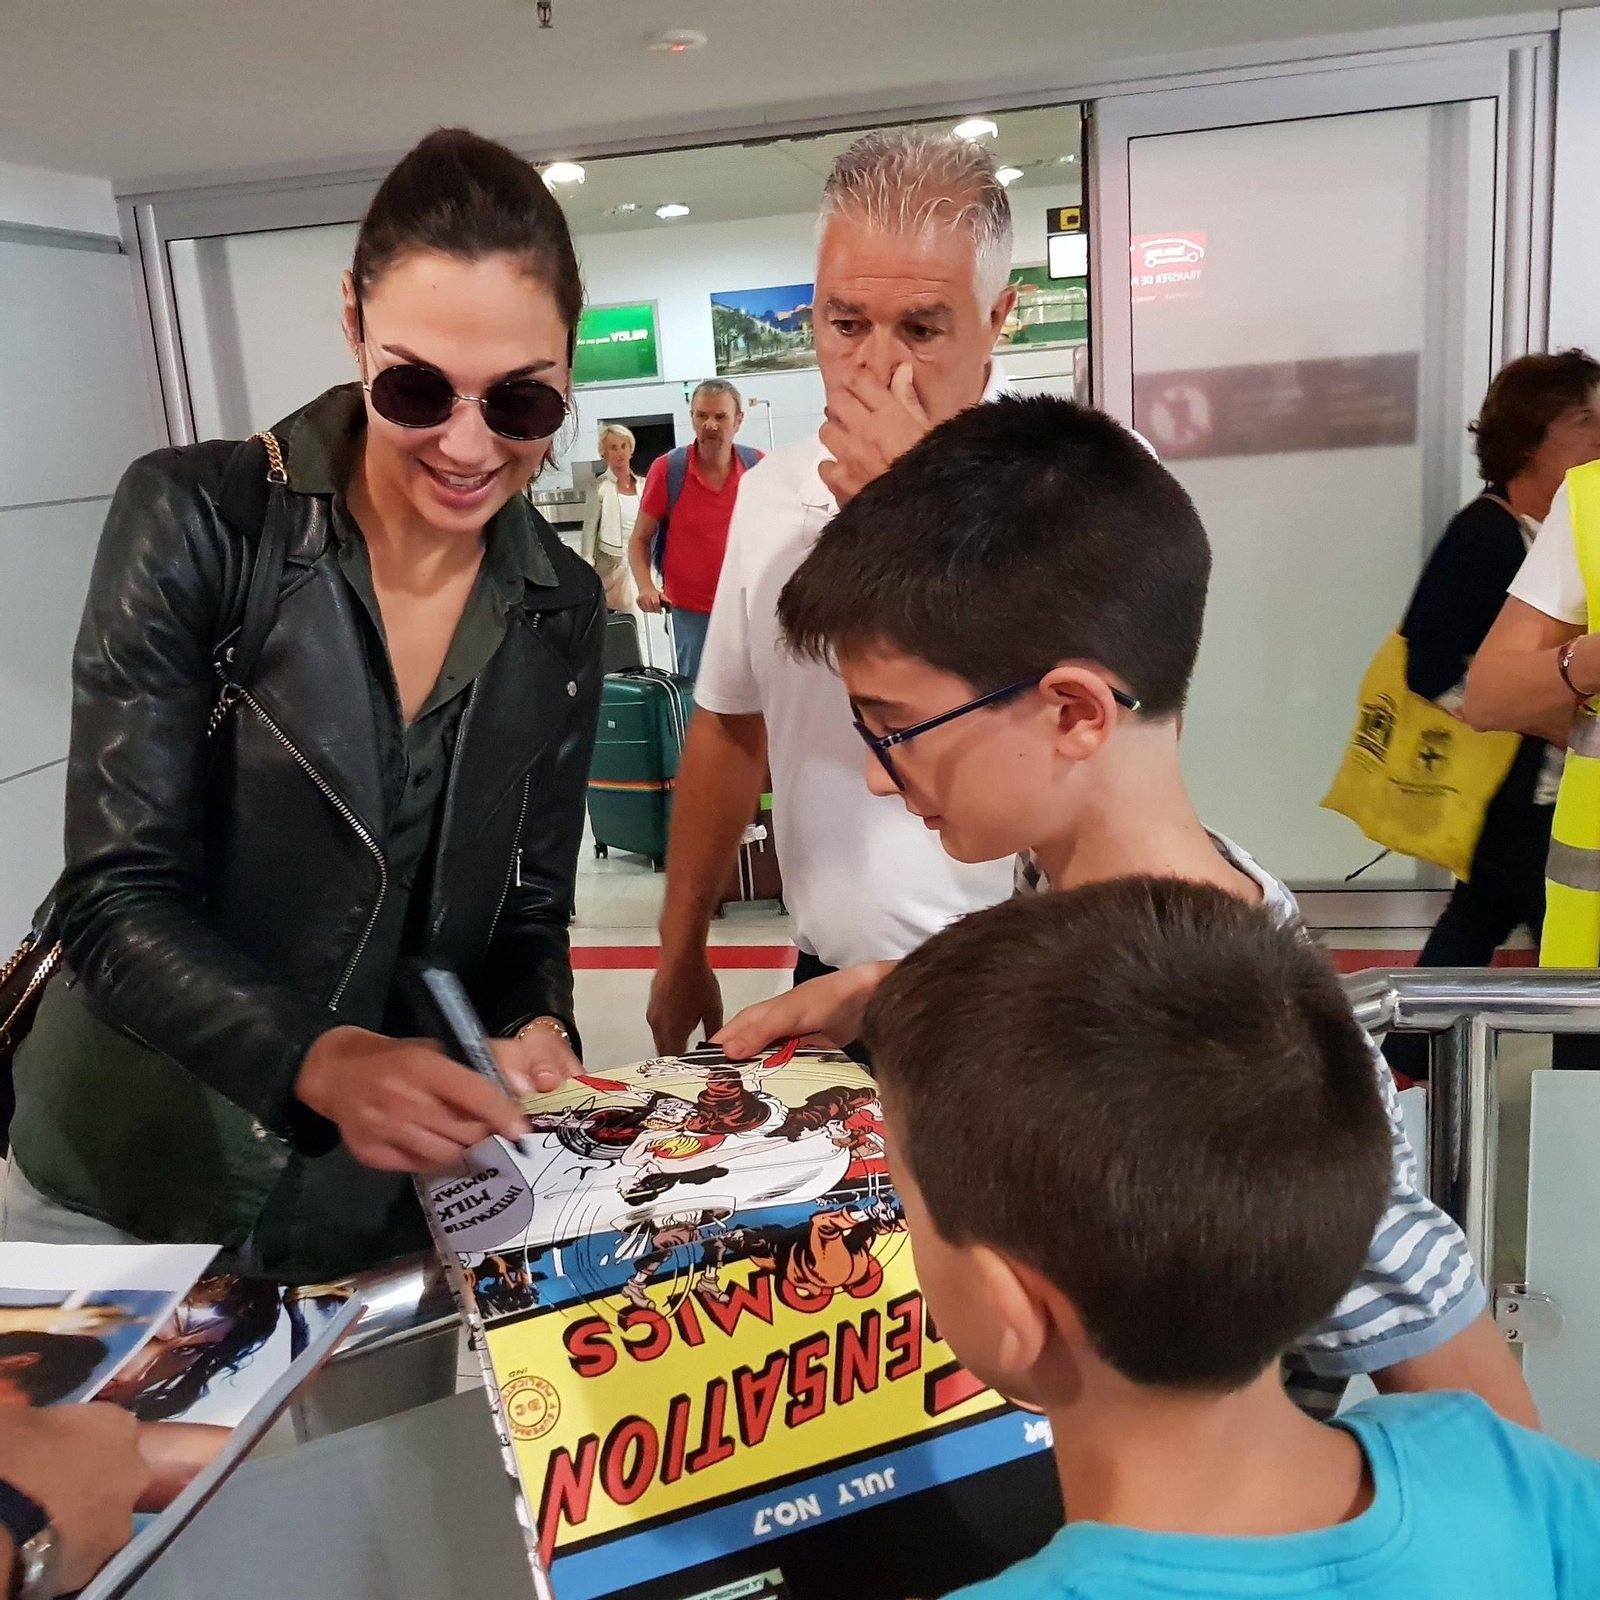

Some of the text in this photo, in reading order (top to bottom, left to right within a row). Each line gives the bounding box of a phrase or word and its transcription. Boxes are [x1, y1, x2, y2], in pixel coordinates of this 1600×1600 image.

[437, 1188, 493, 1222] MILK
[514, 1399, 542, 1416] DC
[753, 1467, 895, 1536] JULY NO.7
